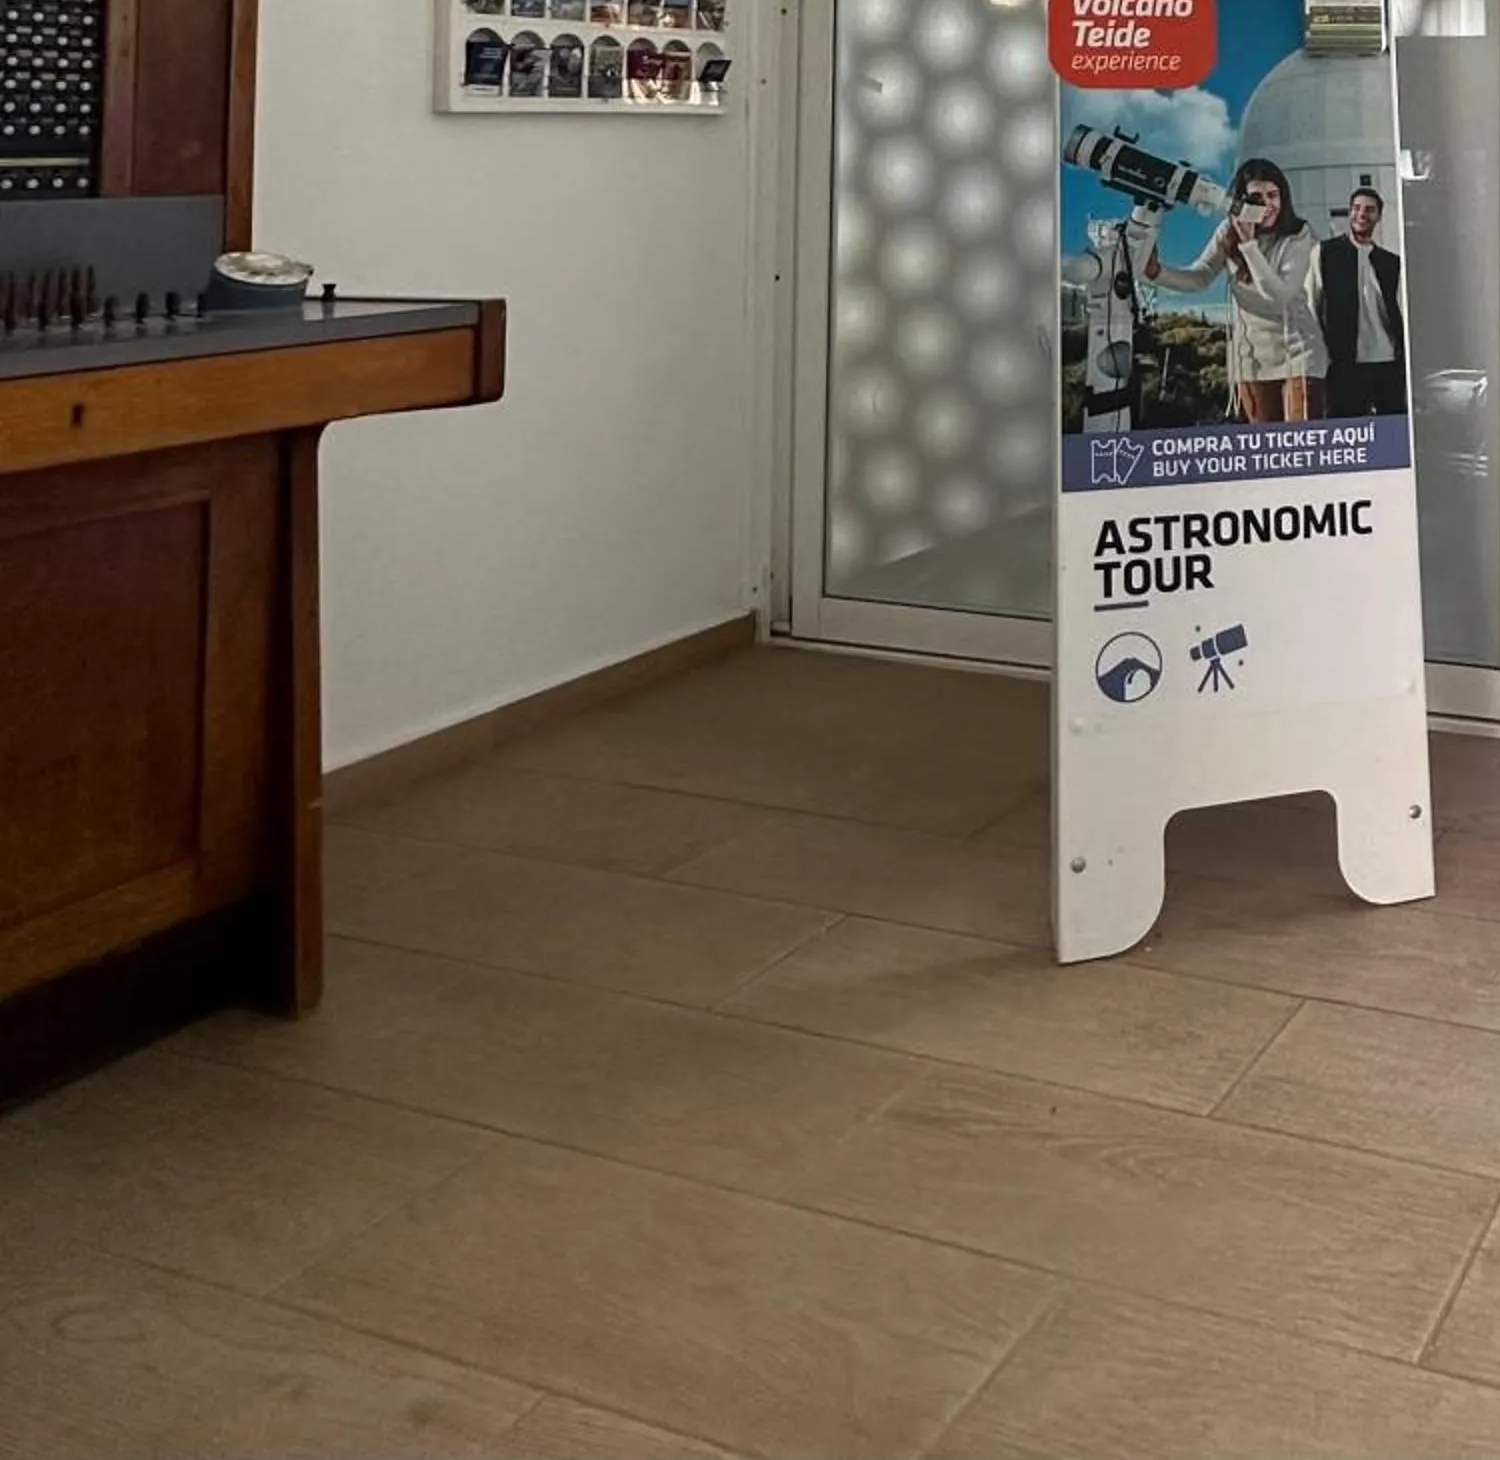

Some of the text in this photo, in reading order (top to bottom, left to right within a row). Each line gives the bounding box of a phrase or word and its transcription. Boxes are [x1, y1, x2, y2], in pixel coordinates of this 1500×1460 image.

[1072, 20, 1151, 47] Teide
[1071, 51, 1182, 75] experience
[1152, 421, 1376, 457] COMPRA TU TICKET AQUÍ
[1152, 447, 1368, 477] BUY YOUR TICKET HERE
[1094, 500, 1373, 557] ASTRONOMIC
[1094, 553, 1214, 599] TOUR
